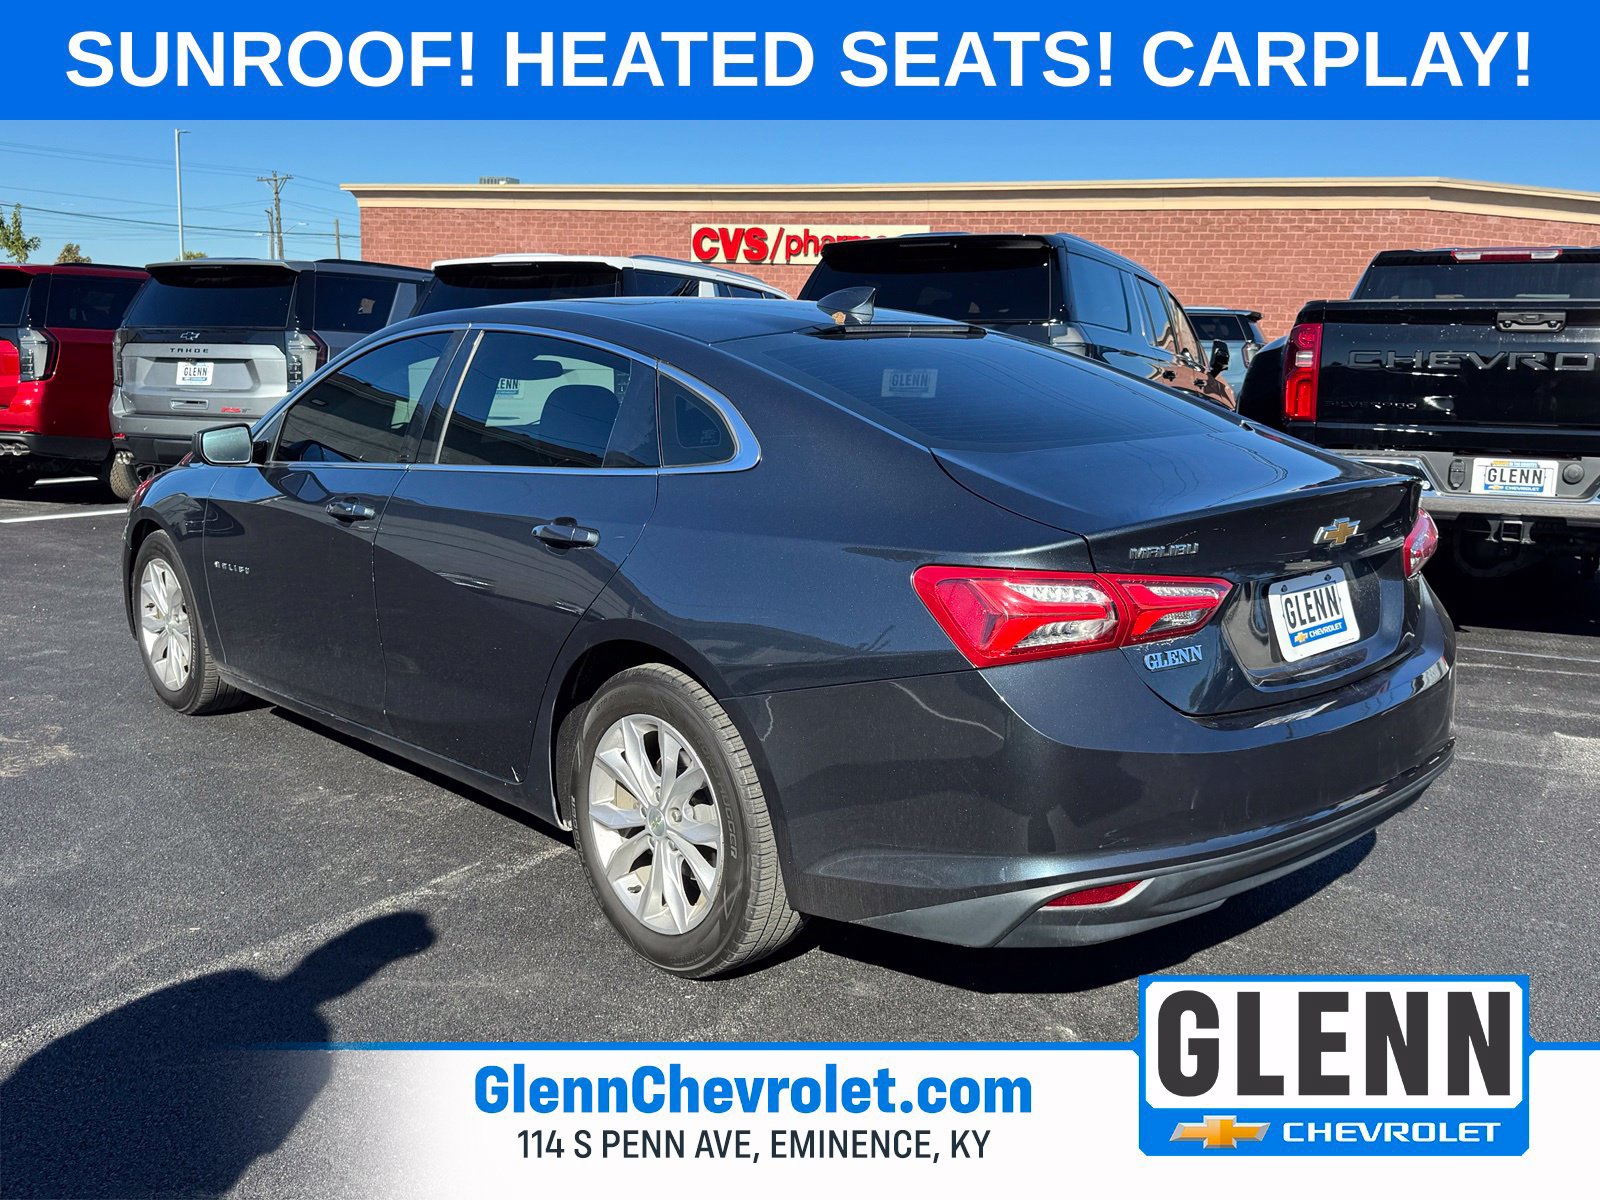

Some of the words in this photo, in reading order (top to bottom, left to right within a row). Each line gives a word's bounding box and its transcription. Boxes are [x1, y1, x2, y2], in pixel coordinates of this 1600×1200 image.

[1347, 350, 1600, 371] CHEVRO
[183, 367, 208, 377] GLENN
[891, 374, 929, 387] GLENN
[1487, 468, 1543, 484] GLENN
[1129, 543, 1199, 560] MALIBU
[1284, 586, 1341, 629] GLENN
[1309, 622, 1343, 638] CHEVROLET
[1143, 645, 1204, 671] GLENN
